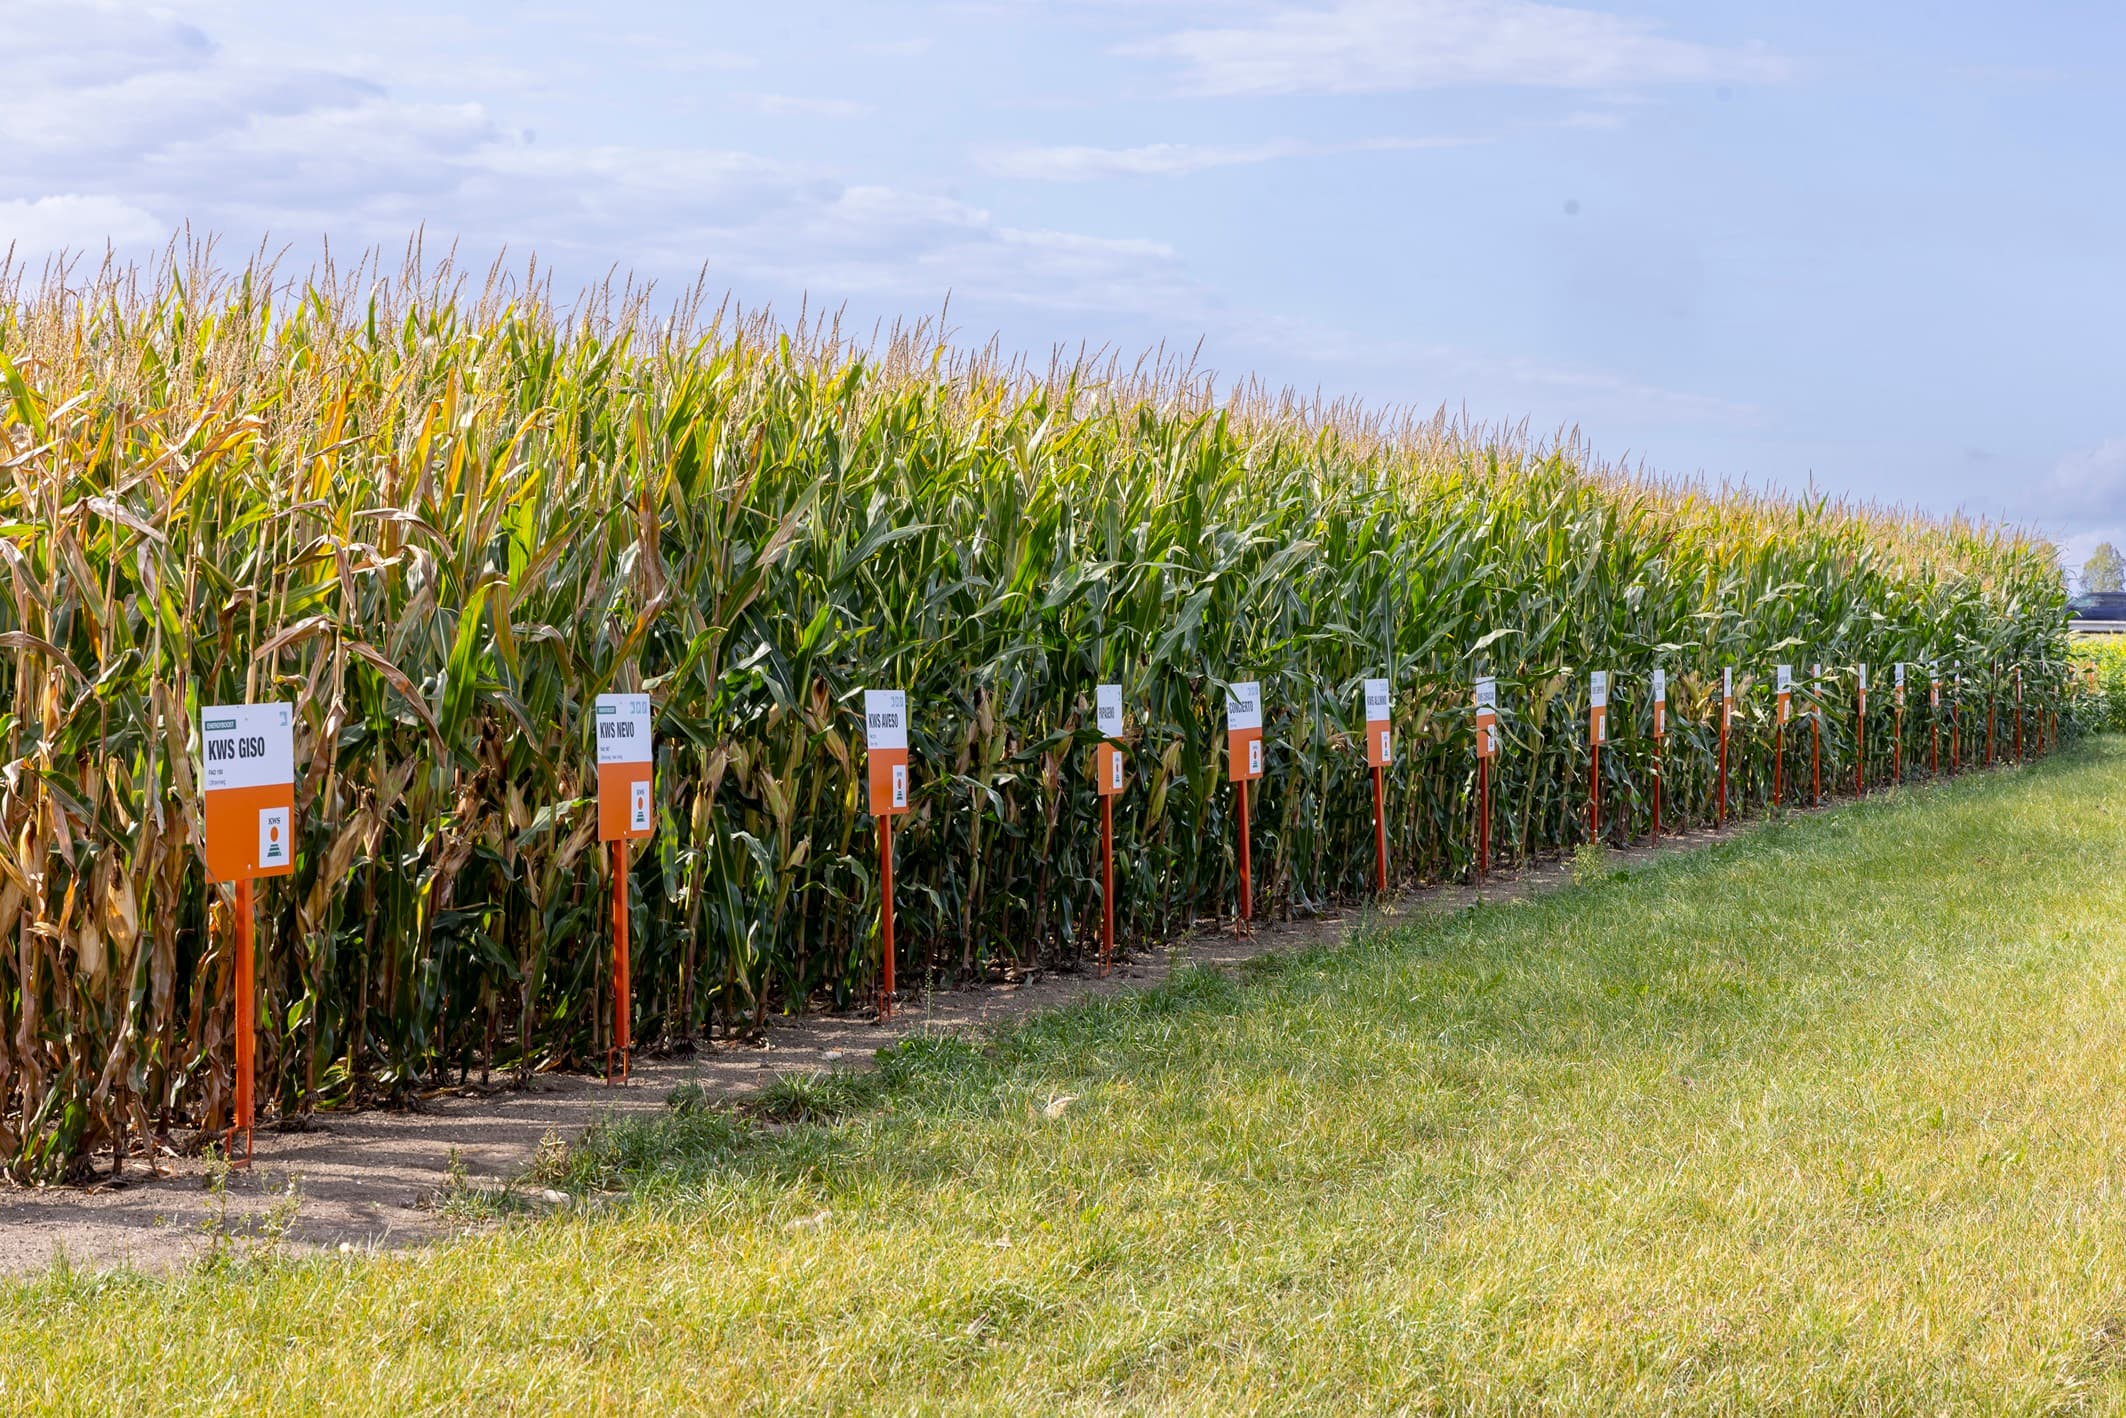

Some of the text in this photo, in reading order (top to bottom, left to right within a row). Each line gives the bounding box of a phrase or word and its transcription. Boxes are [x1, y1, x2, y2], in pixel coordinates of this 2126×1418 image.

[868, 713, 899, 728] KWS AVESO
[599, 721, 635, 738] KWS NEVO
[208, 736, 265, 761] KWS GISO
[268, 817, 281, 825] KWS
